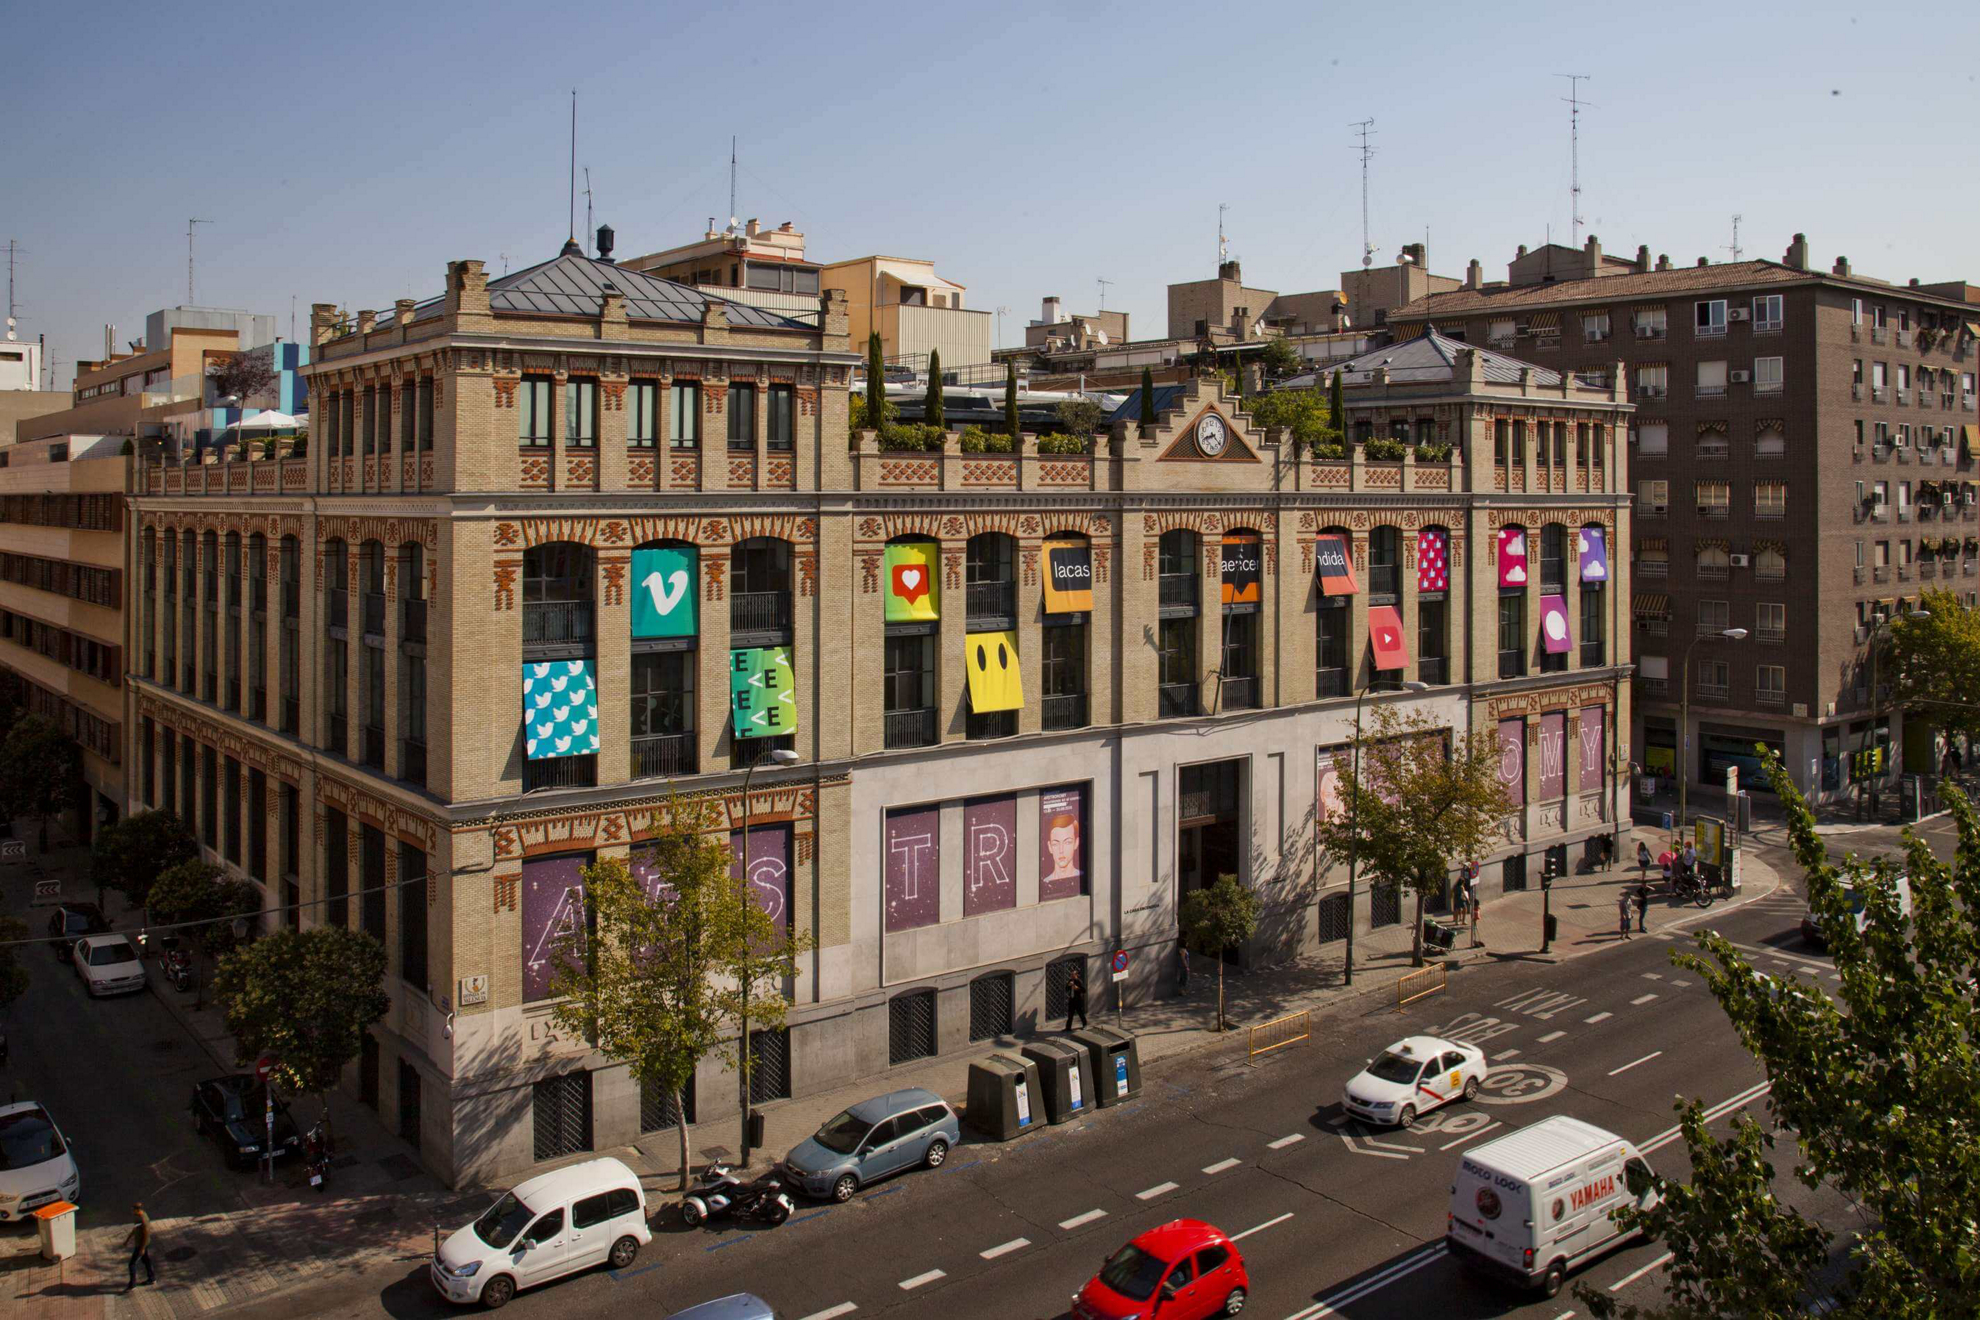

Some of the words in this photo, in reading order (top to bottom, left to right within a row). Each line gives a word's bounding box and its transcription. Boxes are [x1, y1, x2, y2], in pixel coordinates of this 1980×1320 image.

[1053, 560, 1090, 578] lacas
[1580, 726, 1602, 771] Y
[892, 834, 931, 900] T
[971, 824, 1009, 887] R
[1481, 1072, 1545, 1096] 30
[1570, 1175, 1615, 1212] YAMAHA
